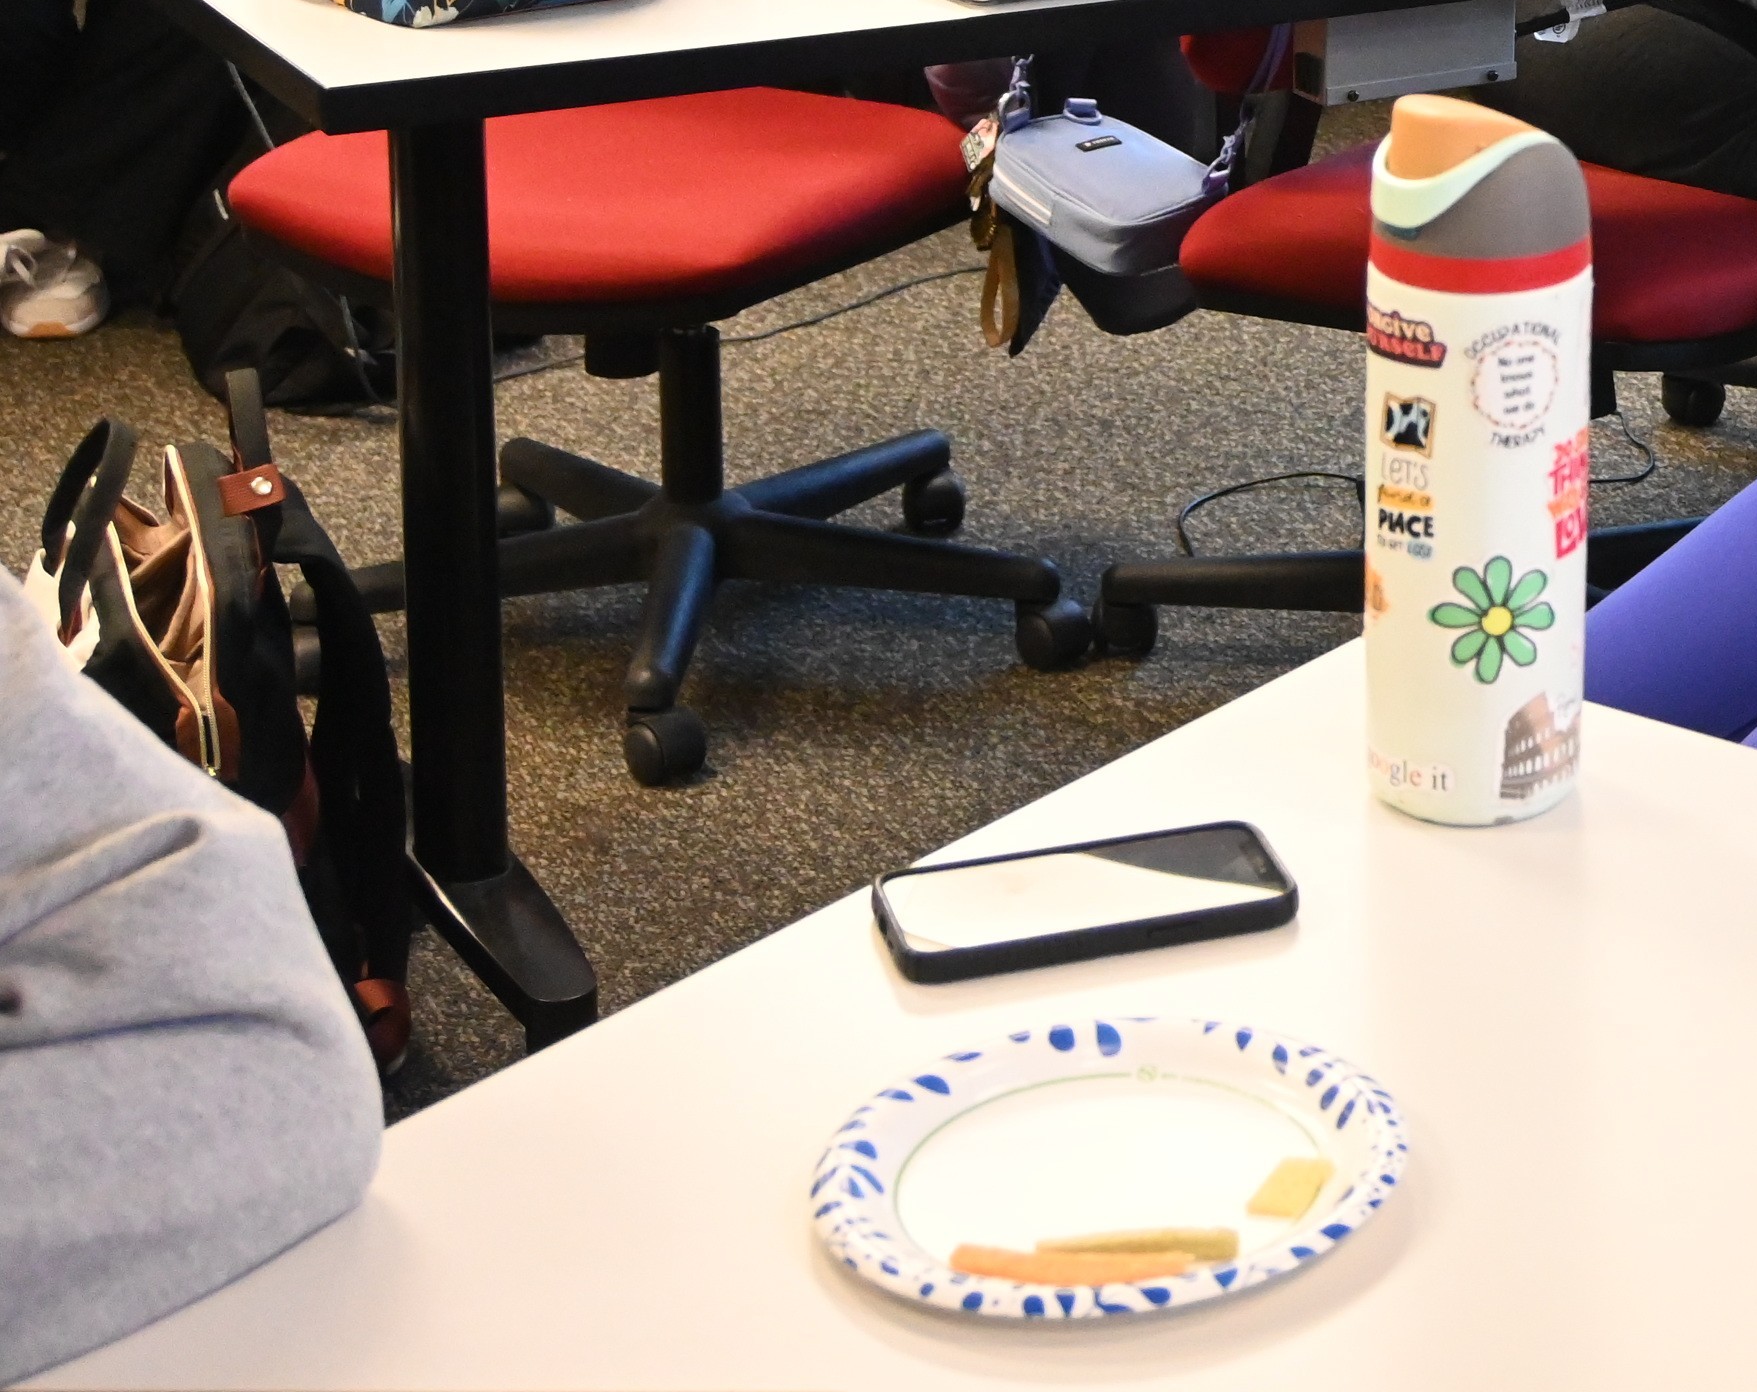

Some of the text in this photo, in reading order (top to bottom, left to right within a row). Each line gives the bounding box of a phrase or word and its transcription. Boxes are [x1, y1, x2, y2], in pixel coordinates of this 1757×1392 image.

[1463, 321, 1562, 358] OCCUPATIONAL
[1489, 425, 1546, 449] THERAPY
[1378, 508, 1434, 538] PLACE
[1366, 744, 1448, 791] oogle it
